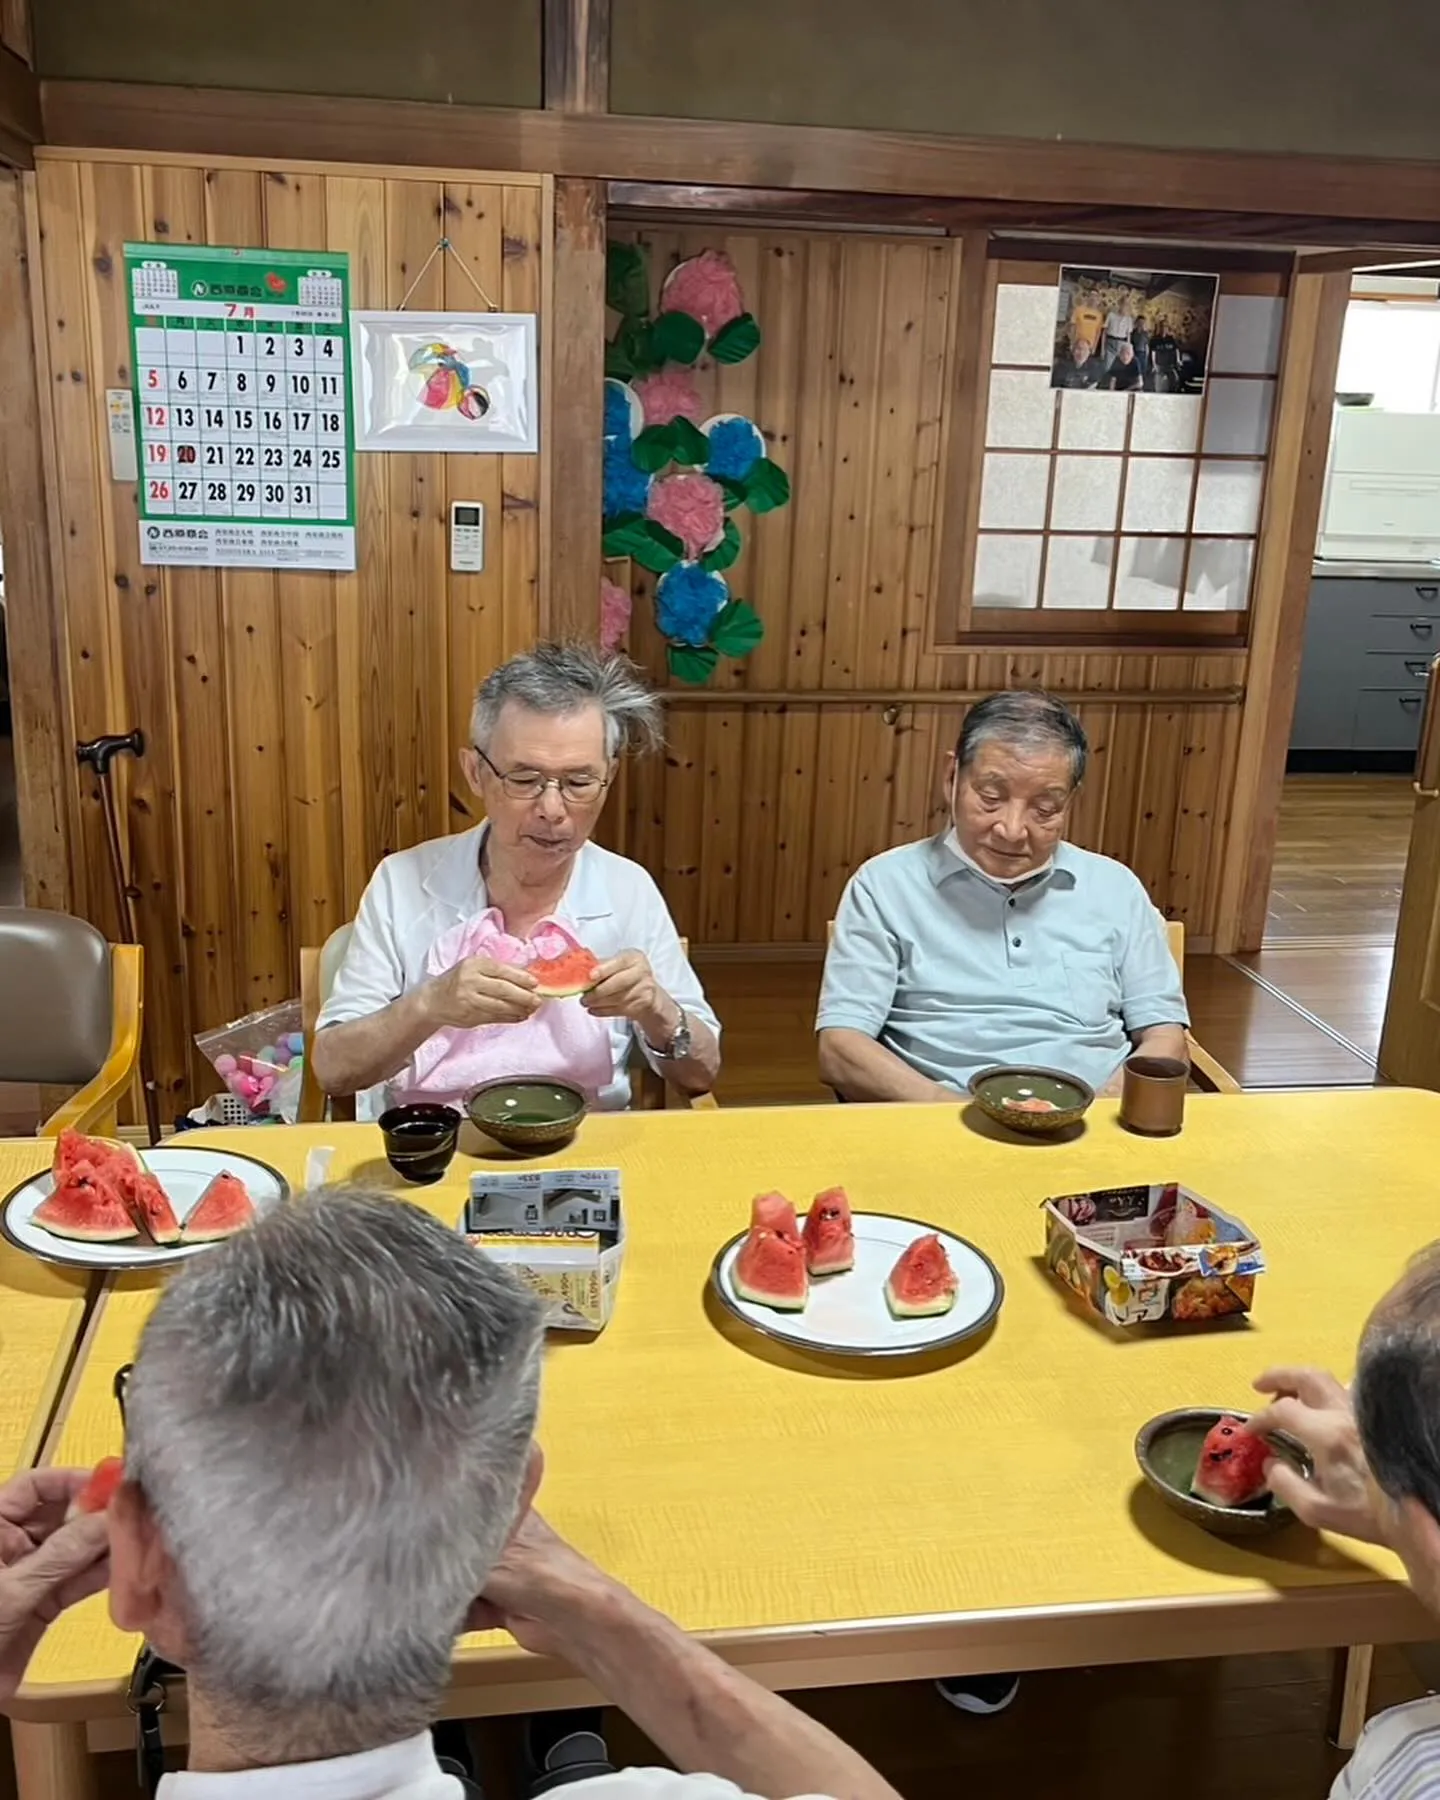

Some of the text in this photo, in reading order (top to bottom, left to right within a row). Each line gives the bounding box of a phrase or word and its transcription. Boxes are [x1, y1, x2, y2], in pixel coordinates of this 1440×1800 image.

[236, 336, 334, 357] 1 2 3 4
[148, 370, 337, 394] 5 6 7 8 9 10 11
[146, 407, 340, 432] 12 13 14 15 16 17 18
[148, 445, 341, 468] 19 20 21 22 23 24 25
[149, 481, 312, 503] 26 27 28 29 30 31
